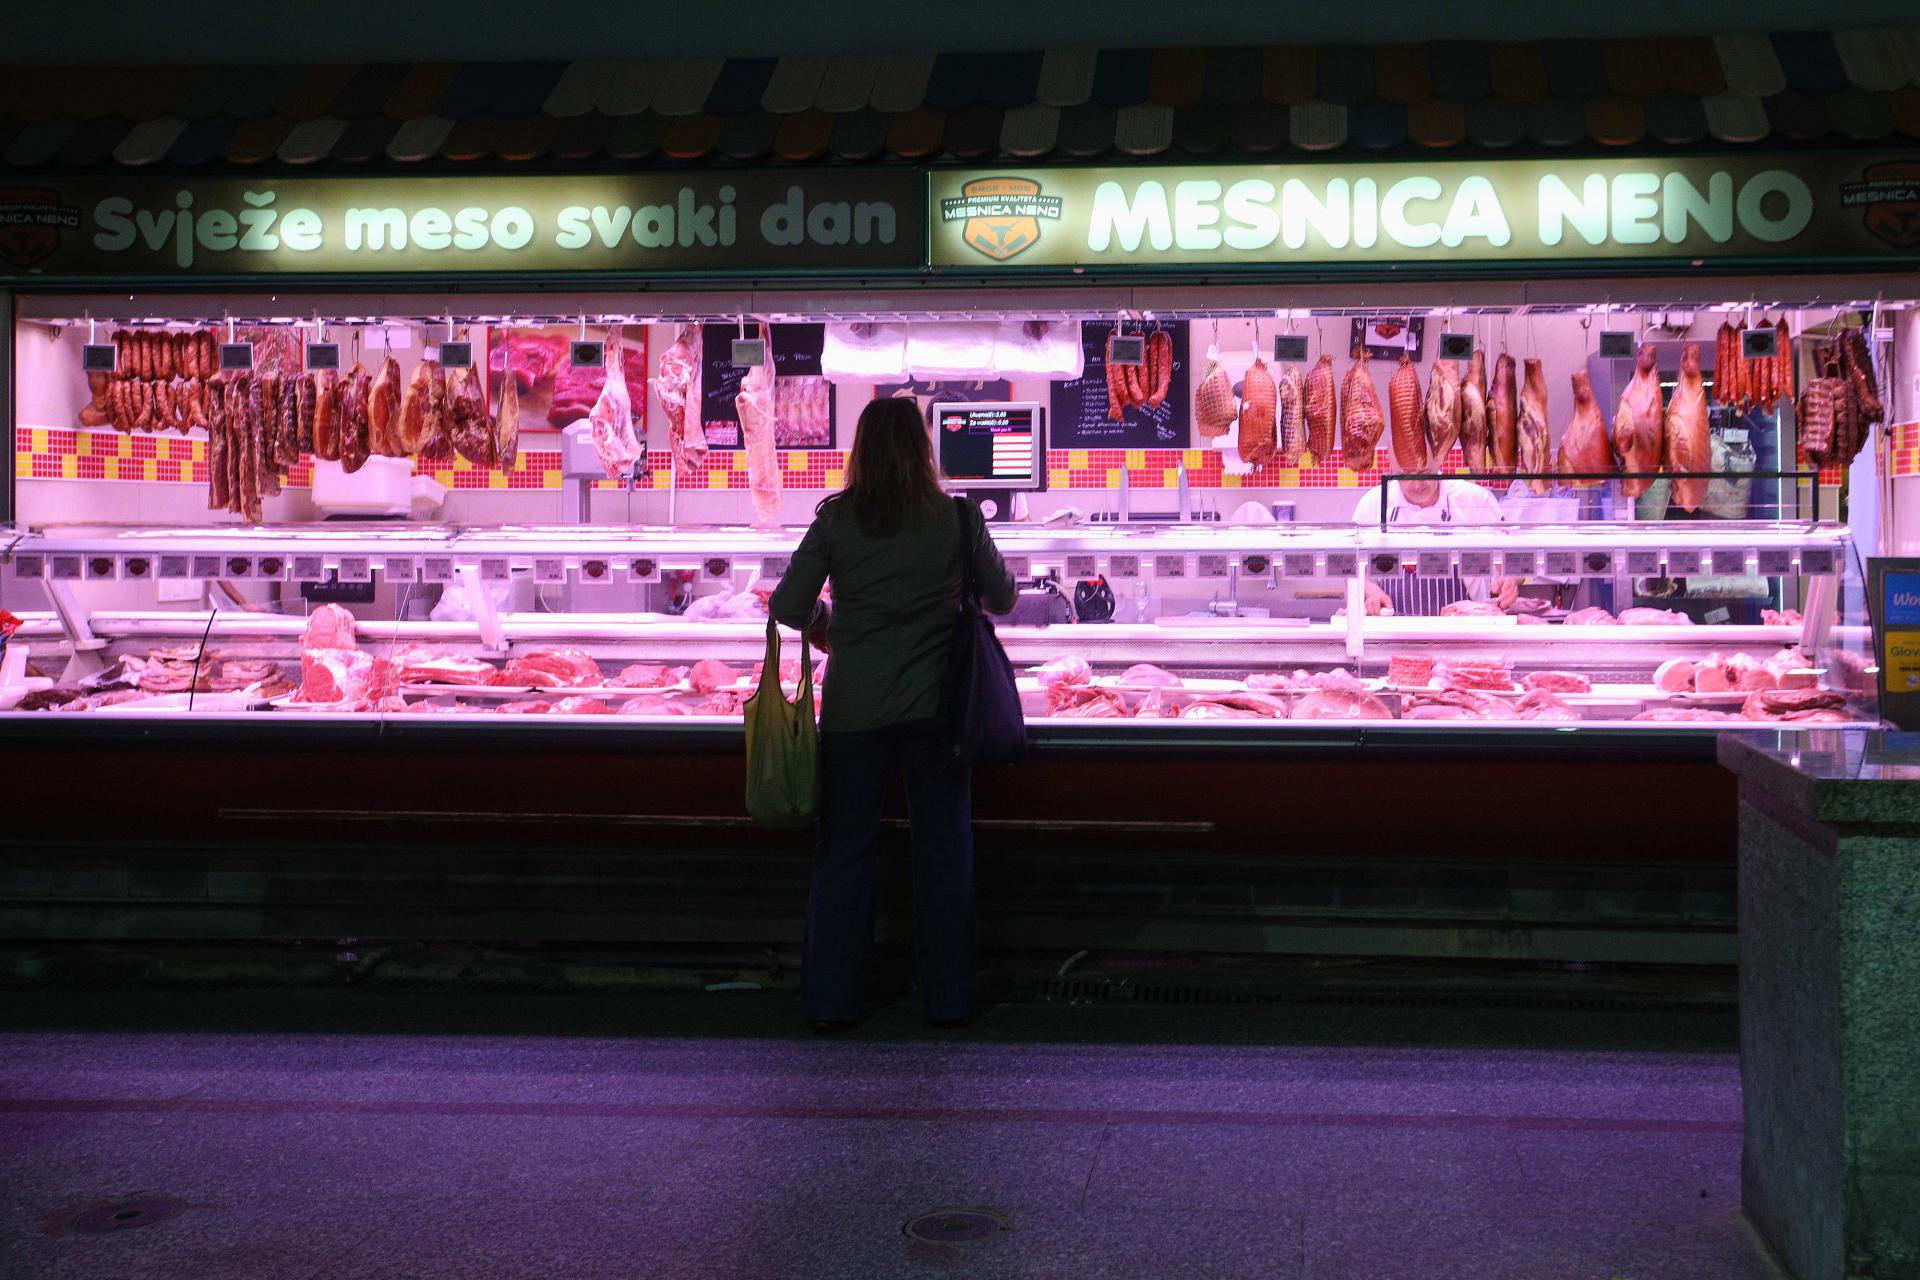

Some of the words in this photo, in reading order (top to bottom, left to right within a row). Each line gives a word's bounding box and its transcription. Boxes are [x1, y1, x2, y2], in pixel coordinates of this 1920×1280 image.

[1843, 190, 1917, 204] MESNICA
[944, 204, 1012, 220] MESNICA
[1015, 204, 1060, 219] NENO
[1087, 175, 1511, 252] MESNICA
[1538, 170, 1814, 246] NENO
[36, 213, 79, 226] NENO
[93, 190, 323, 269] Svježe
[344, 206, 535, 251] meso
[555, 184, 737, 250] svaki
[760, 185, 896, 246] dan
